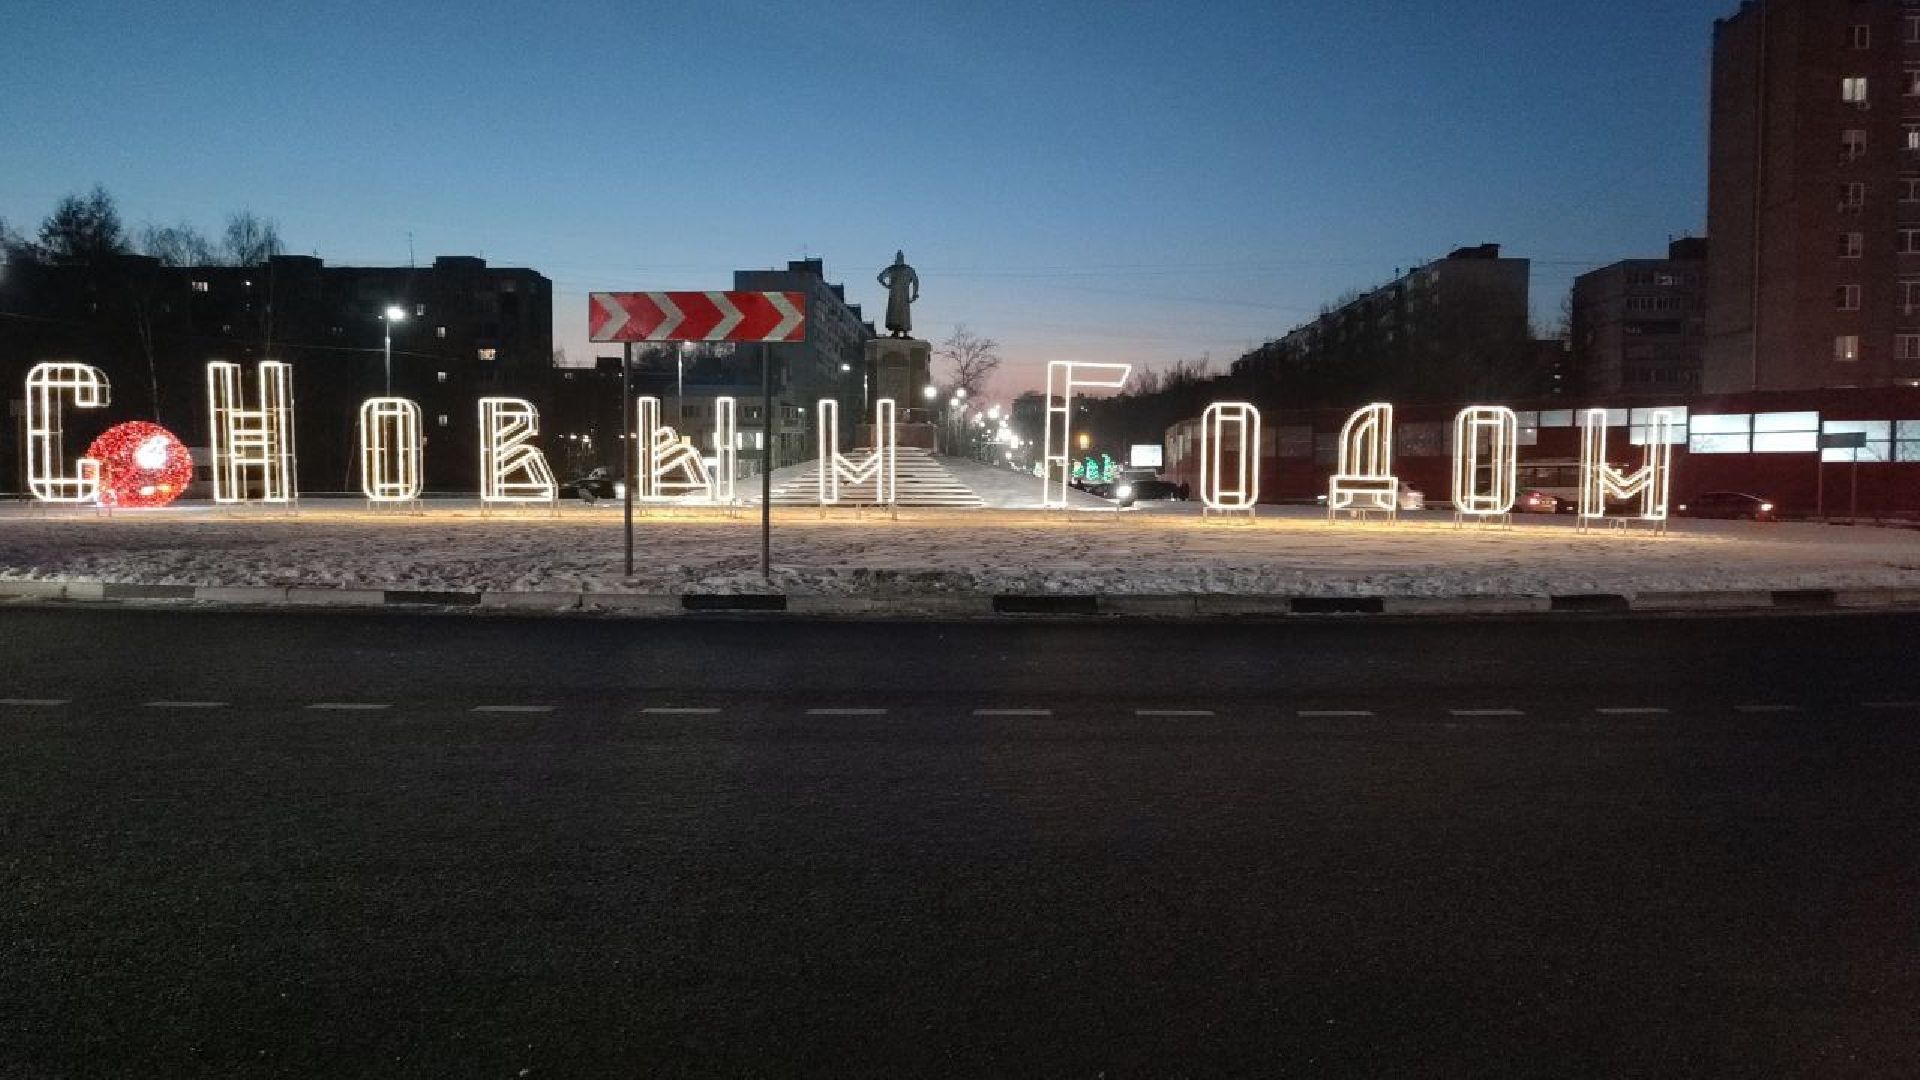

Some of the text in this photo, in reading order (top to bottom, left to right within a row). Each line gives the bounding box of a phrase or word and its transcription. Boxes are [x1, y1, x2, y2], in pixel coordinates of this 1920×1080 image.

[26, 360, 1672, 521] С НОВЫМ ГОДОМ
